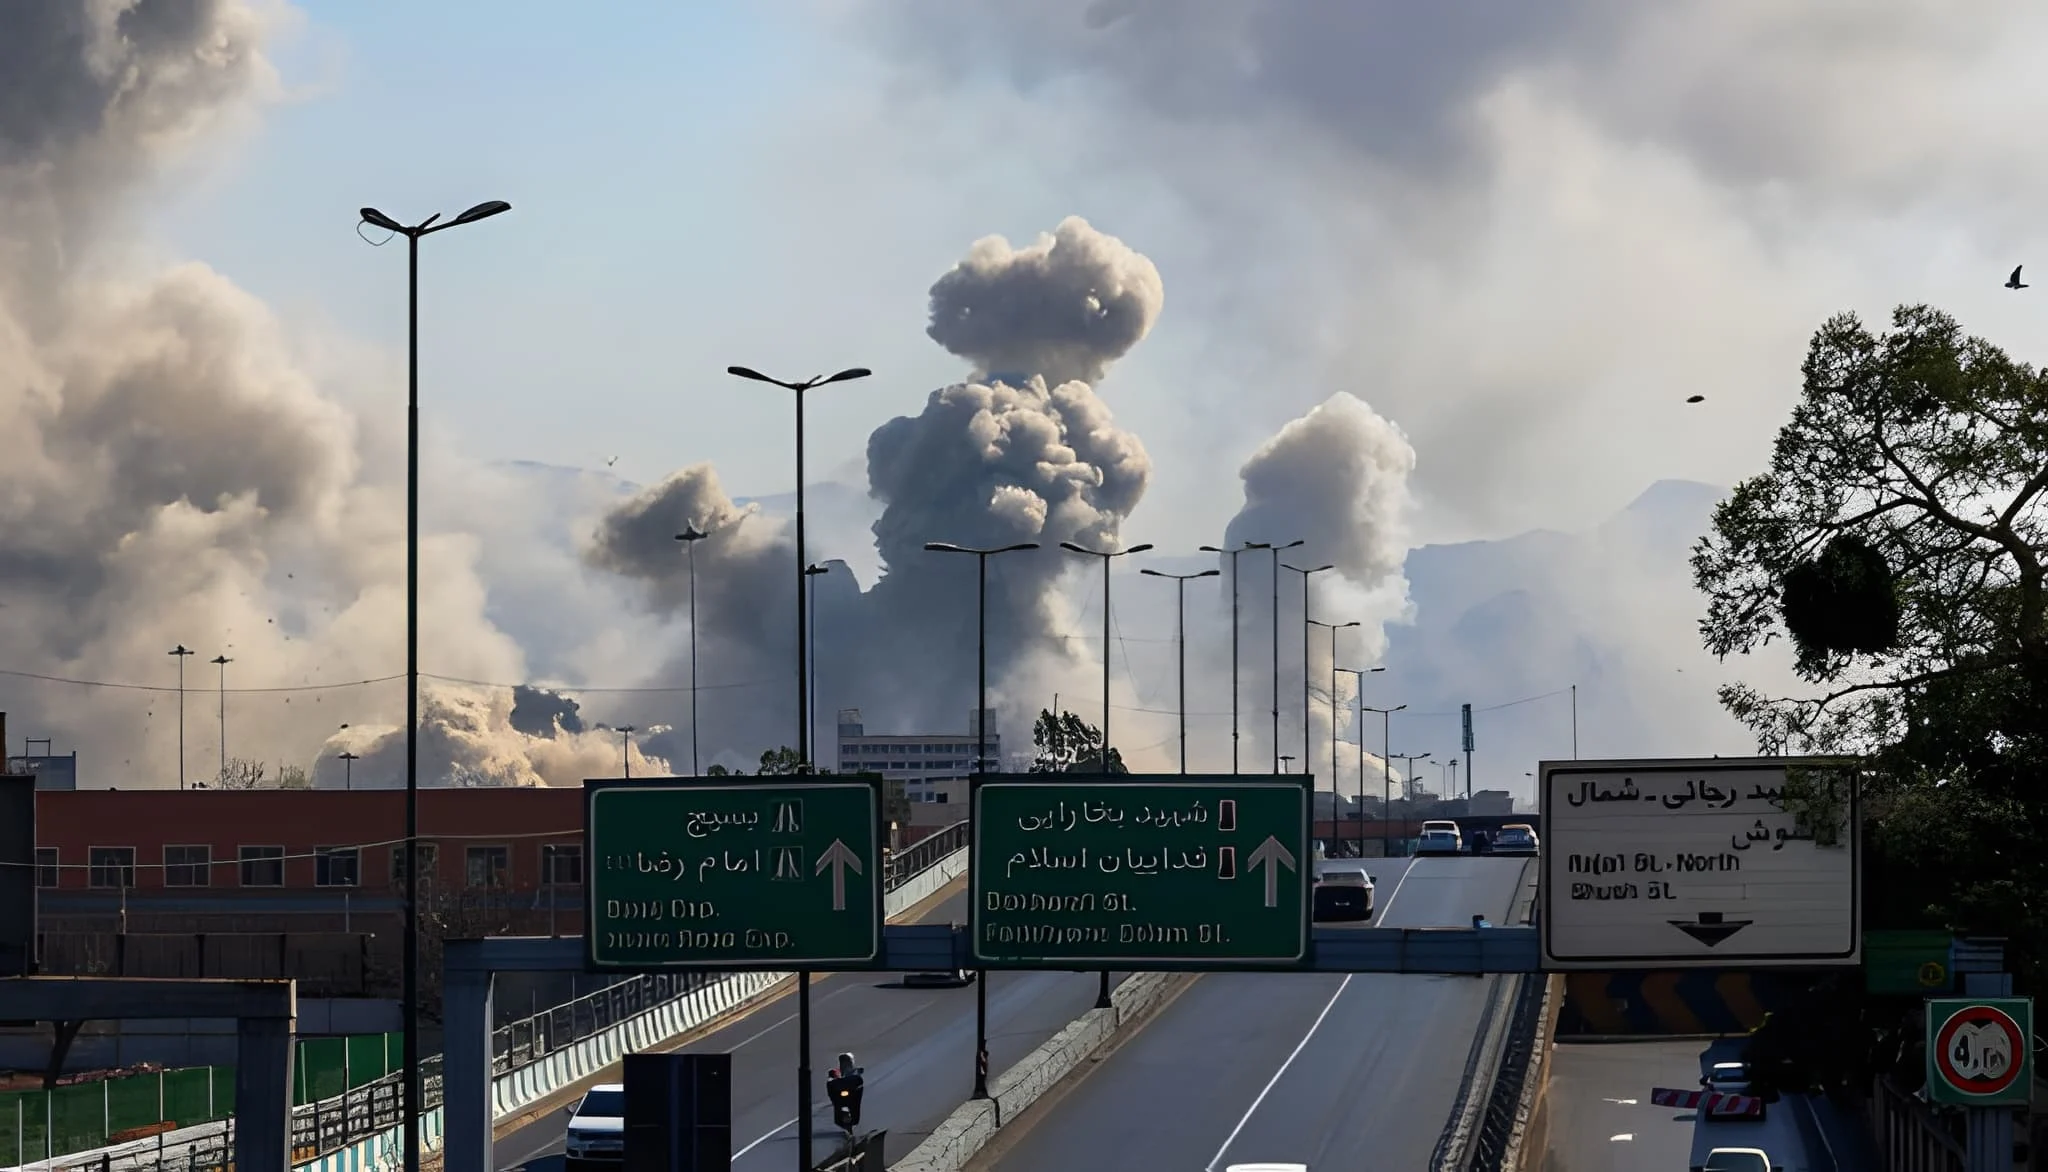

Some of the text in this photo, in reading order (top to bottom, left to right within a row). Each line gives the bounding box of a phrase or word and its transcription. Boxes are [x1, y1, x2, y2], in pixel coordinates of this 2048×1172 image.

[686, 811, 759, 838] بسیج
[637, 851, 685, 880] رضا
[698, 850, 760, 882] امام
[1006, 847, 1087, 878] اسلام
